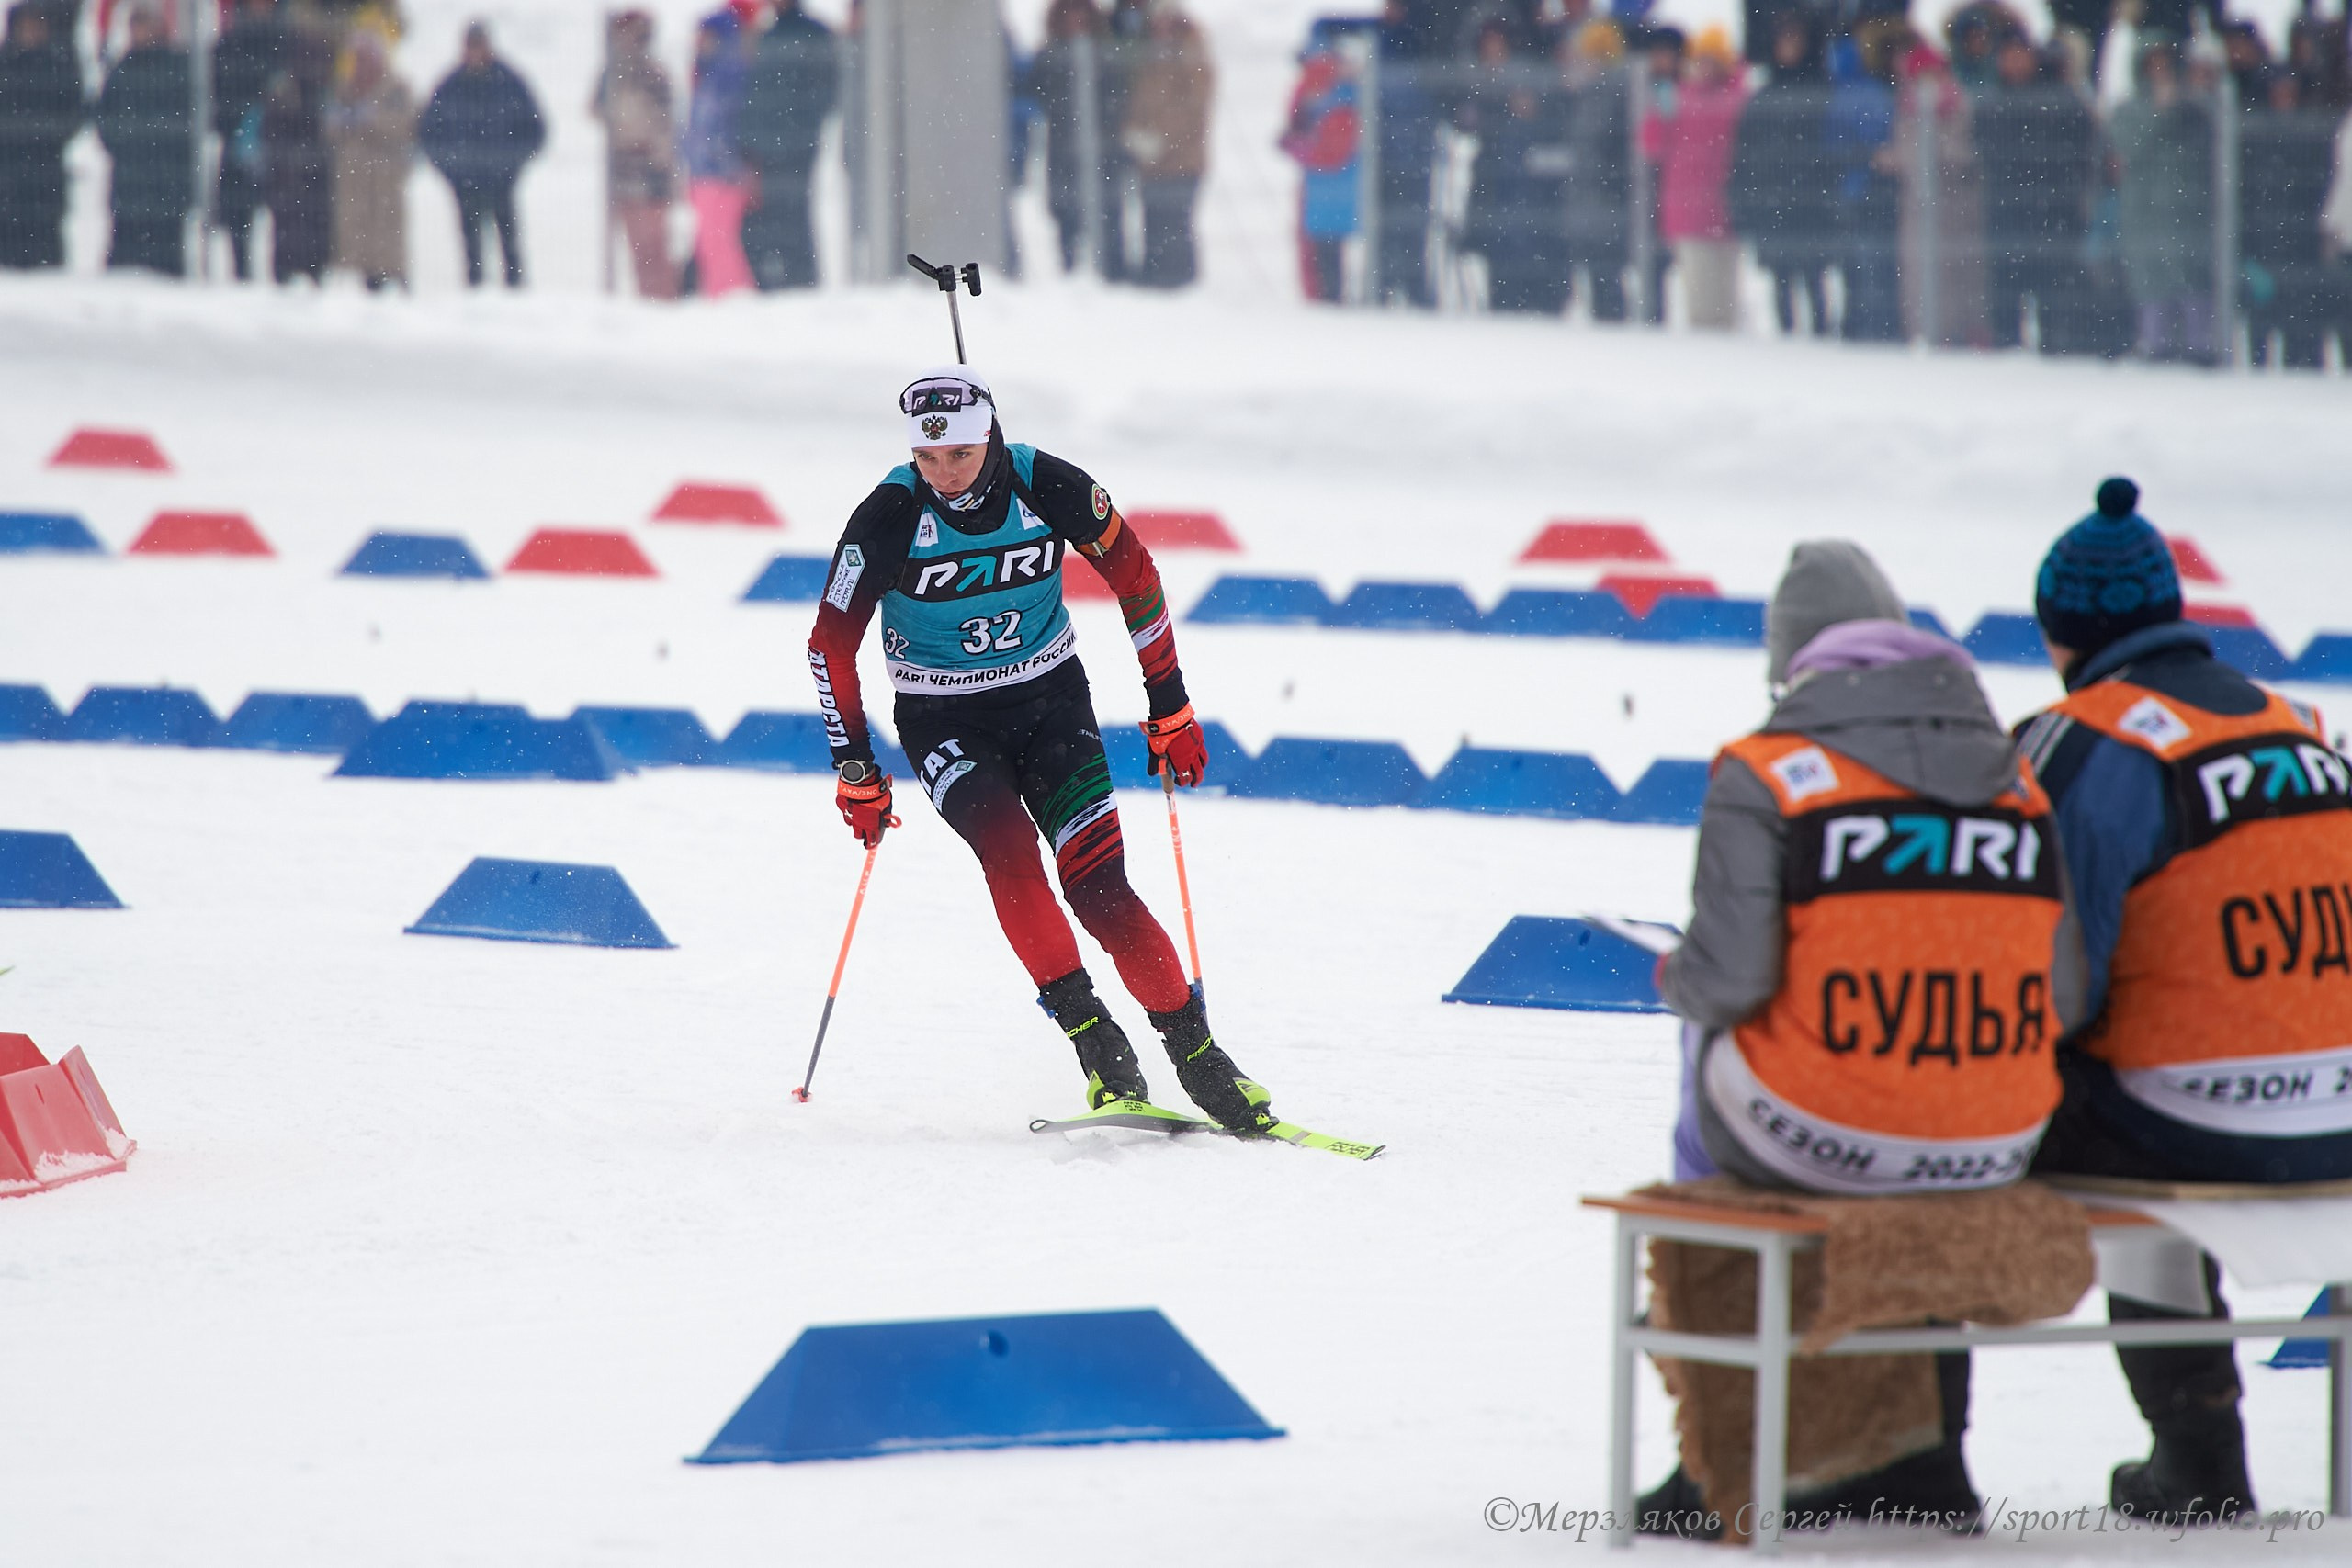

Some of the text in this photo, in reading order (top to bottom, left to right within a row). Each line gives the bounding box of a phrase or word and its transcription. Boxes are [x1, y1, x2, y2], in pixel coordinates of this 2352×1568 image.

[914, 540, 1055, 595] PARI
[884, 627, 910, 659] 32
[960, 611, 1023, 655] 32
[895, 669, 925, 683] PARI
[929, 660, 1030, 686] ЧЕМПИОНАТ
[2197, 743, 2352, 825] PAR
[1820, 814, 2041, 881] PARI
[2221, 883, 2352, 980] СУД
[1821, 969, 2044, 1068] СУДЬЯ
[1748, 1097, 1877, 1175] СЕЗОН
